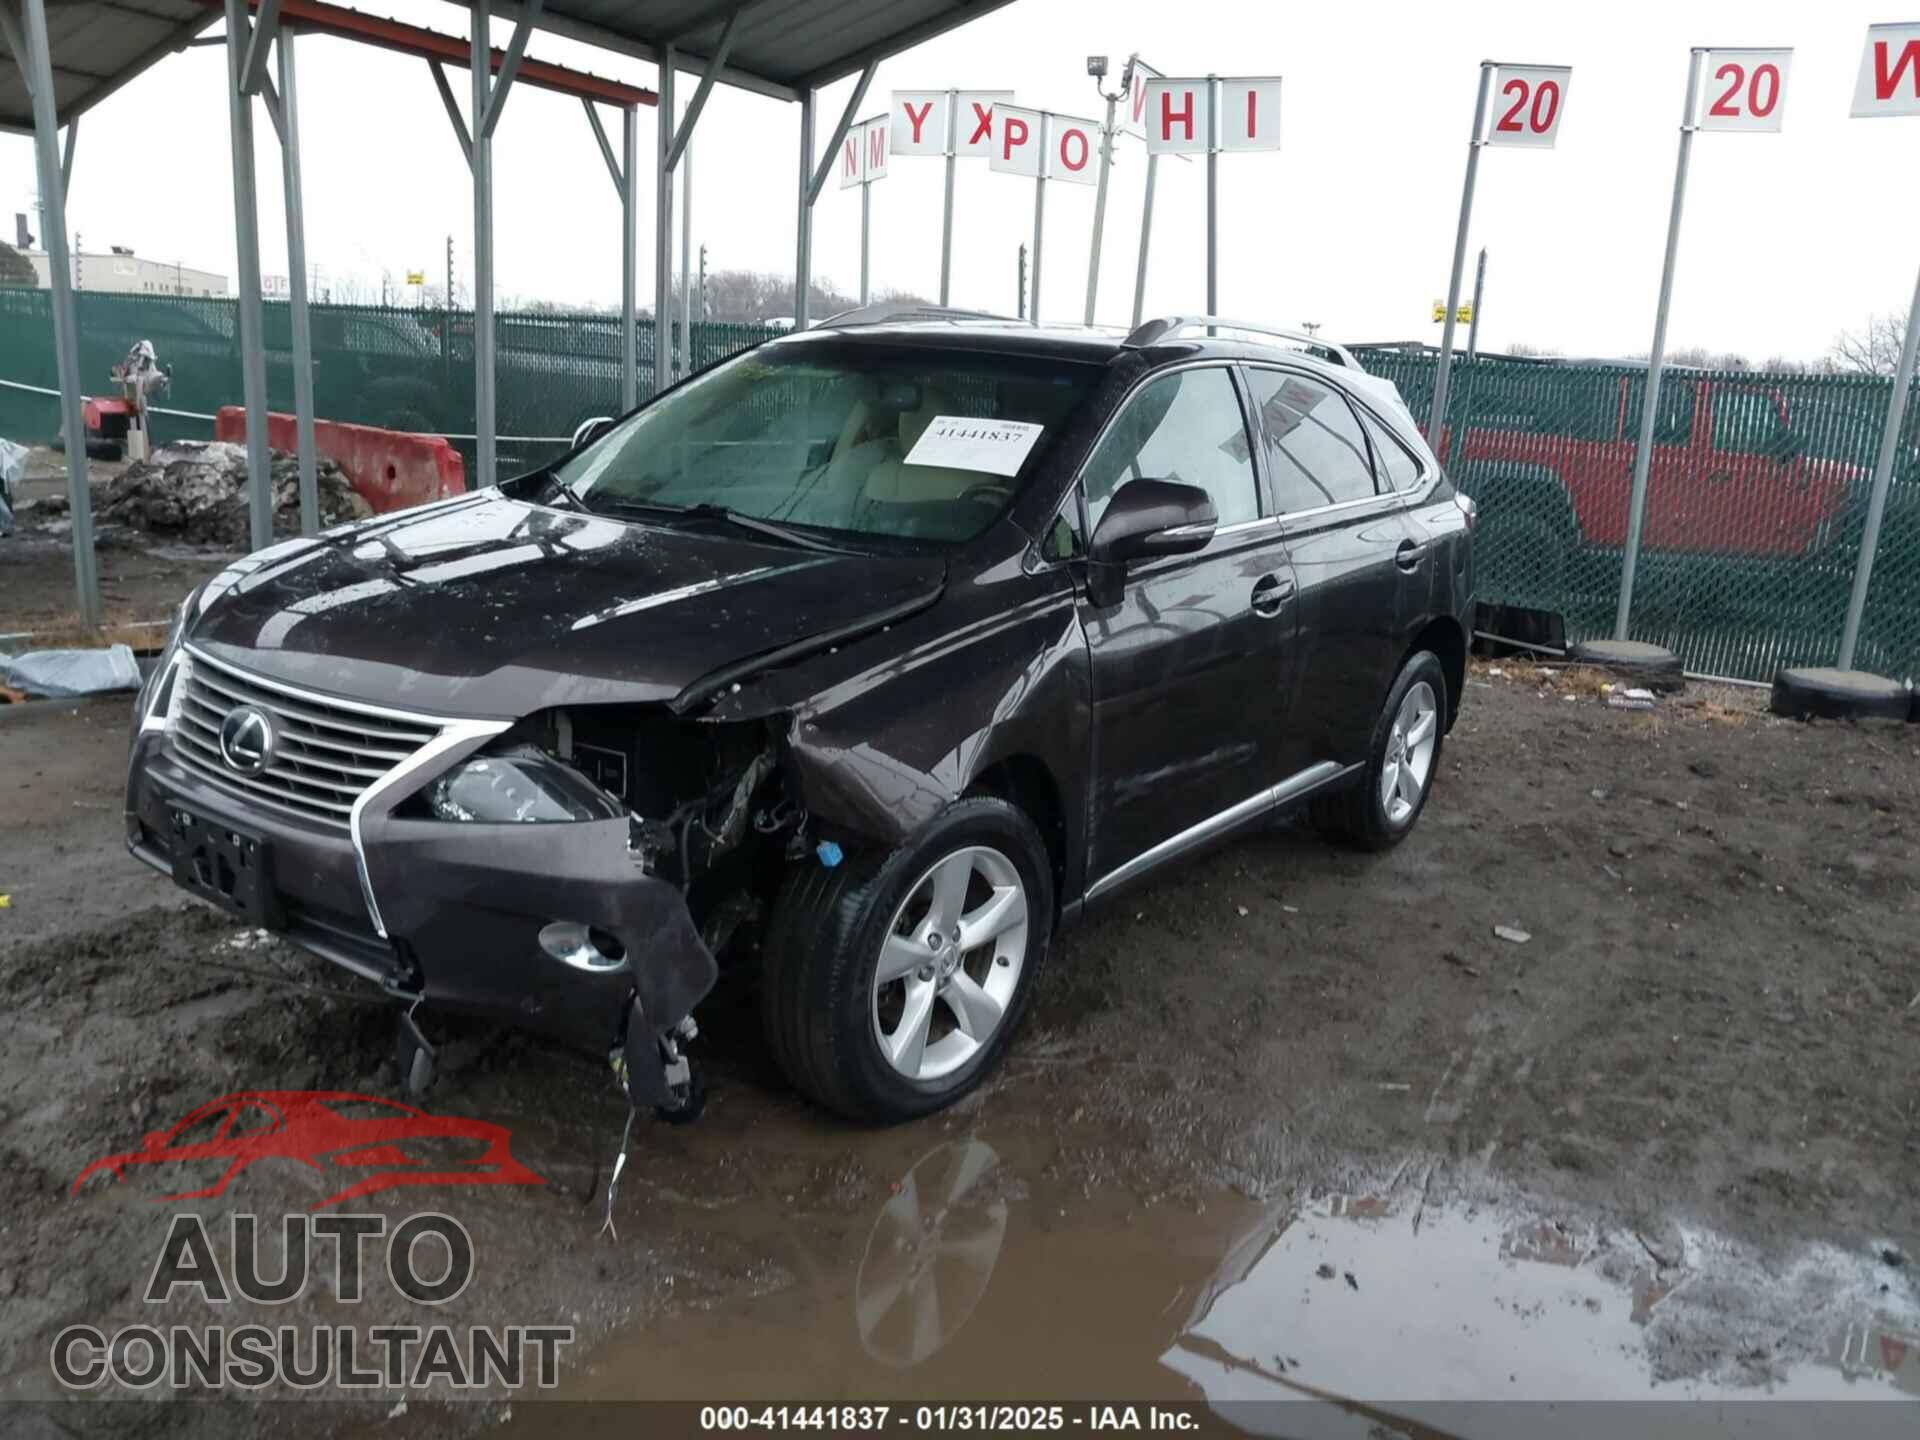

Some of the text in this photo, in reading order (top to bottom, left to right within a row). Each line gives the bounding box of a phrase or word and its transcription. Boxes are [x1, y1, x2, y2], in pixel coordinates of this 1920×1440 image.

[1161, 91, 1194, 141] H
[1247, 90, 1257, 139] I
[1496, 79, 1560, 134] 20
[1709, 63, 1781, 119] 20
[903, 102, 993, 145] Y X
[1003, 117, 1089, 172] P O
[845, 127, 885, 177] N M
[936, 427, 1024, 442] 41441837
